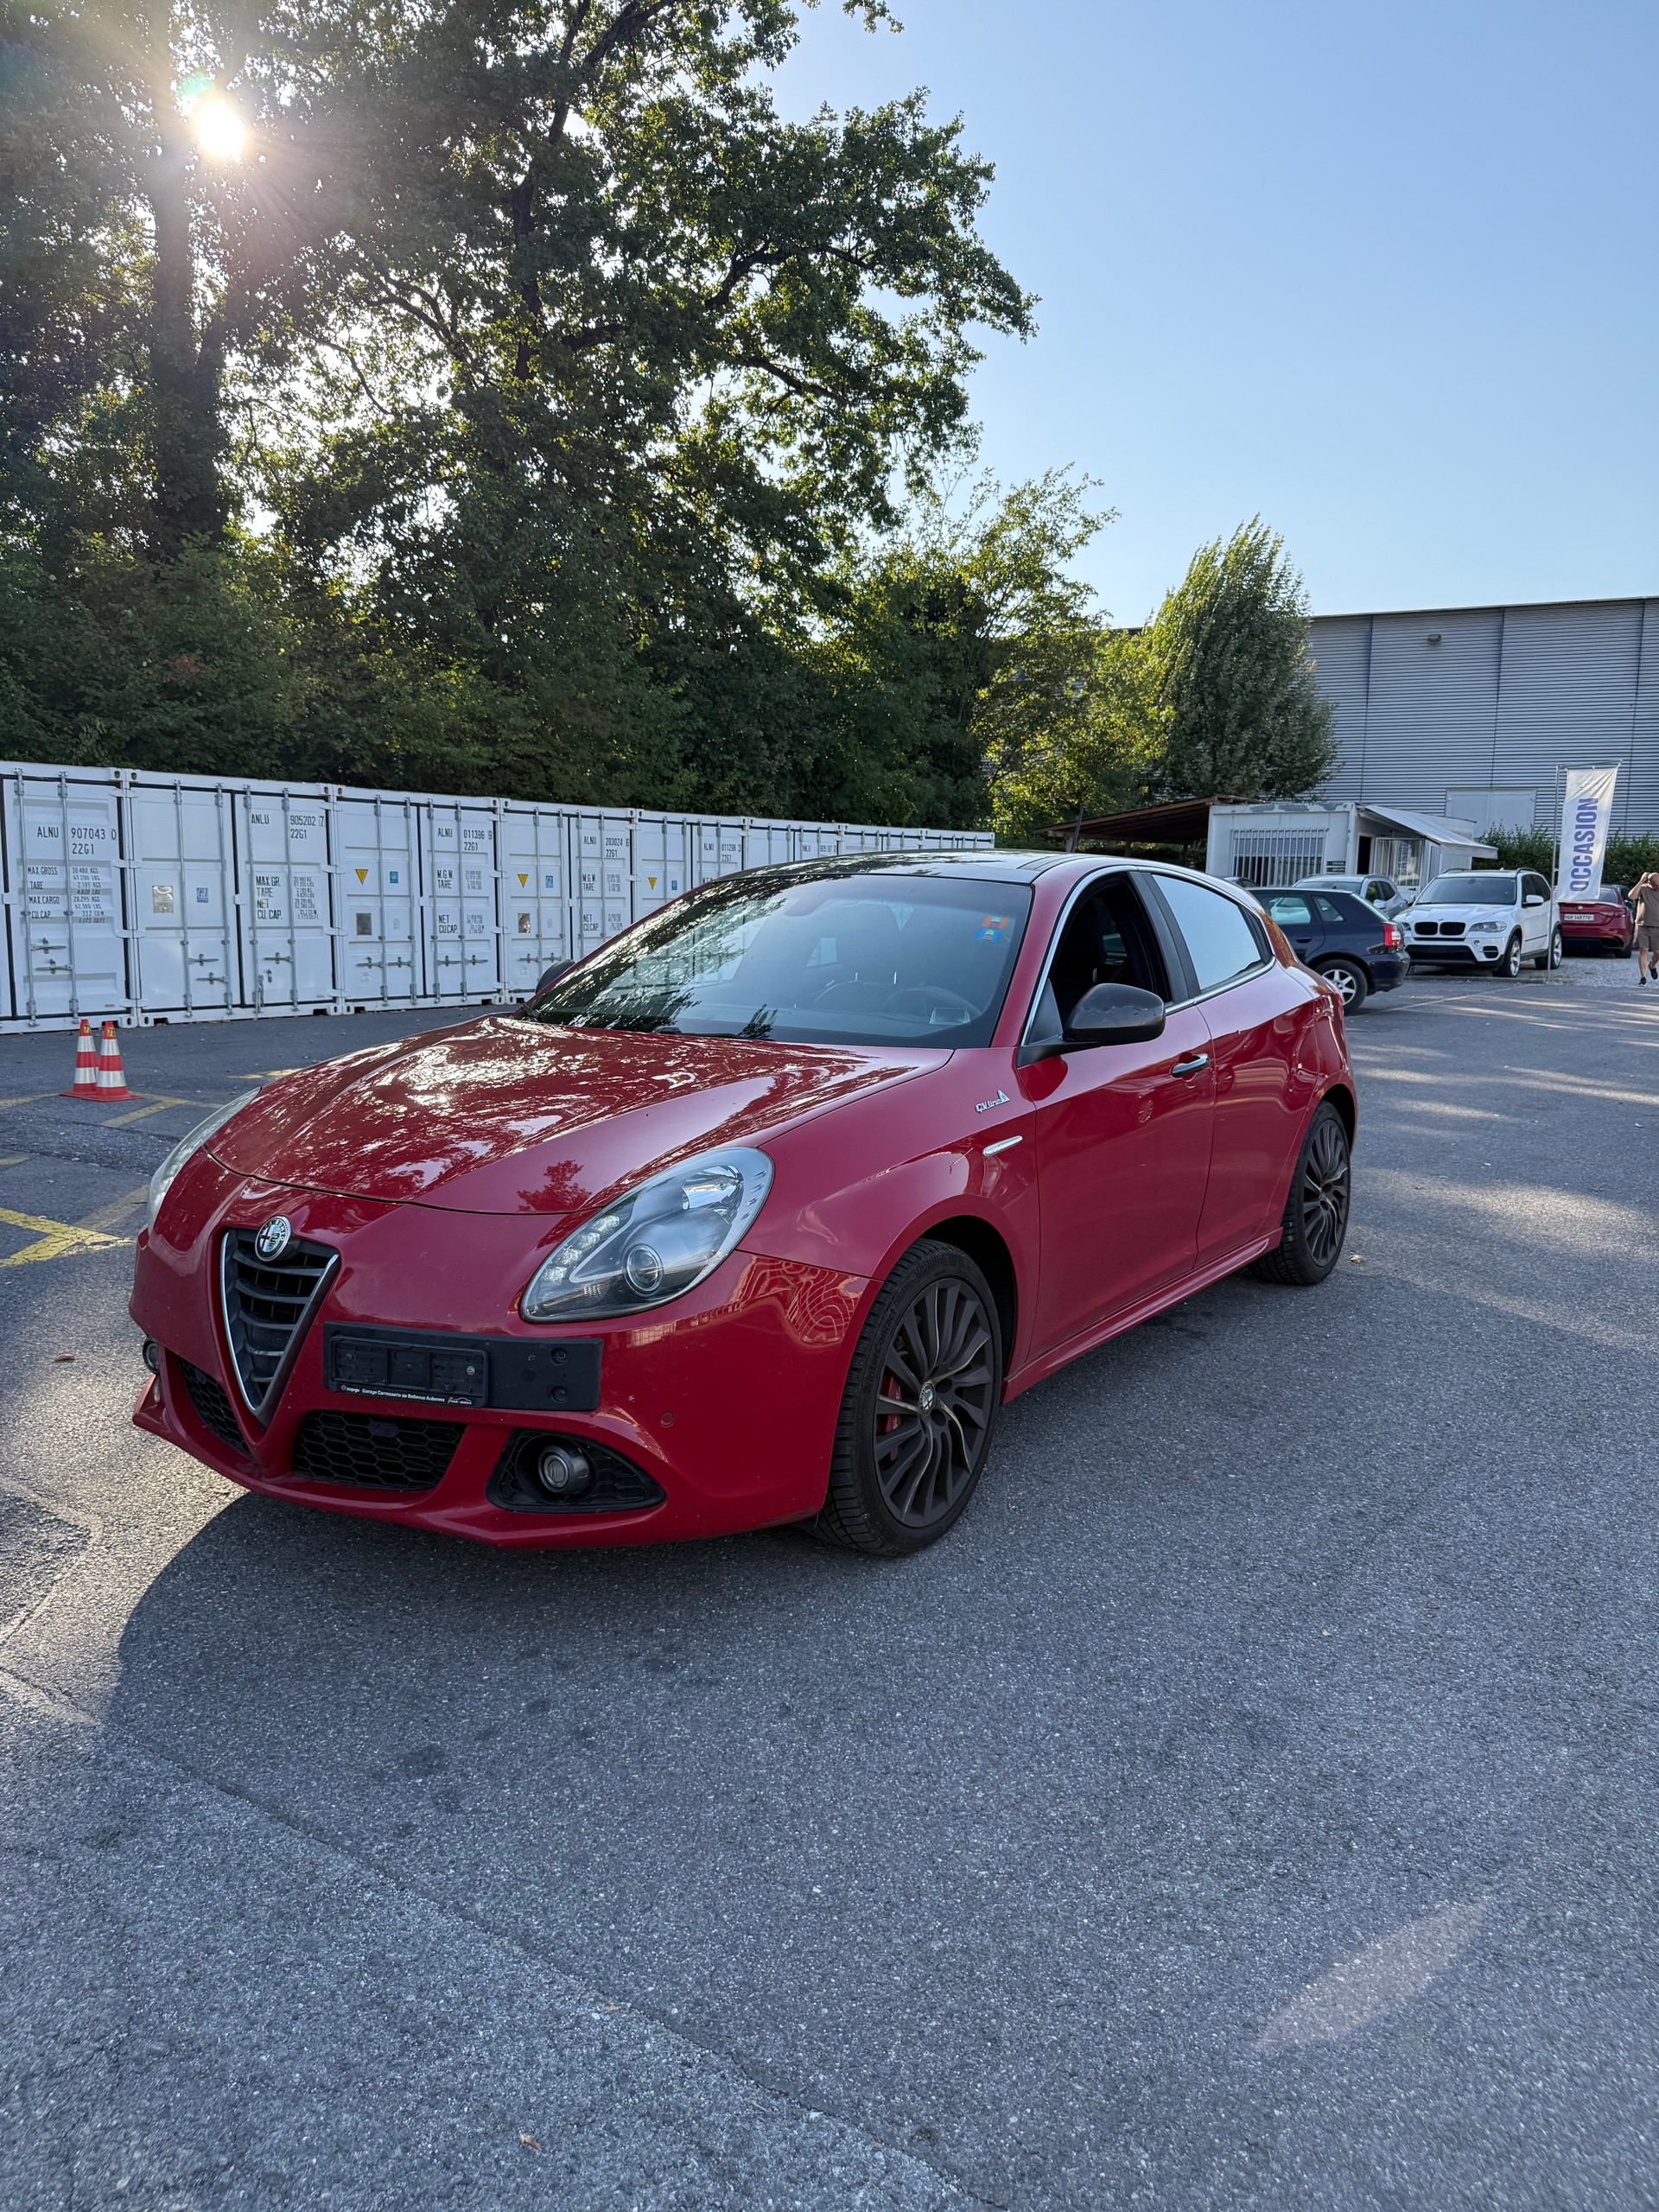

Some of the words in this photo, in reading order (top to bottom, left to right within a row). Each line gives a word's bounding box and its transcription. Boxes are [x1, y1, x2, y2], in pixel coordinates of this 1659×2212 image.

[251, 814, 270, 824] ANLU
[290, 815, 316, 826] 905202
[37, 826, 59, 838] ALNU
[71, 827, 105, 840] 907043
[290, 829, 307, 839] 22G1
[437, 828, 453, 838] ALNU
[583, 836, 597, 845] ALNU
[1569, 798, 1599, 892] OCCASION
[72, 842, 94, 855] 22G1
[30, 880, 43, 890] TARE
[437, 880, 452, 889] TARE
[582, 883, 595, 892] TARE
[197, 888, 208, 899] GL
[257, 887, 274, 898] TARE
[257, 899, 270, 909] NET
[438, 914, 450, 925] NET
[583, 914, 593, 923] NET
[864, 1307, 896, 1394] WinterContact
[378, 1389, 402, 1398] Carrosserie
